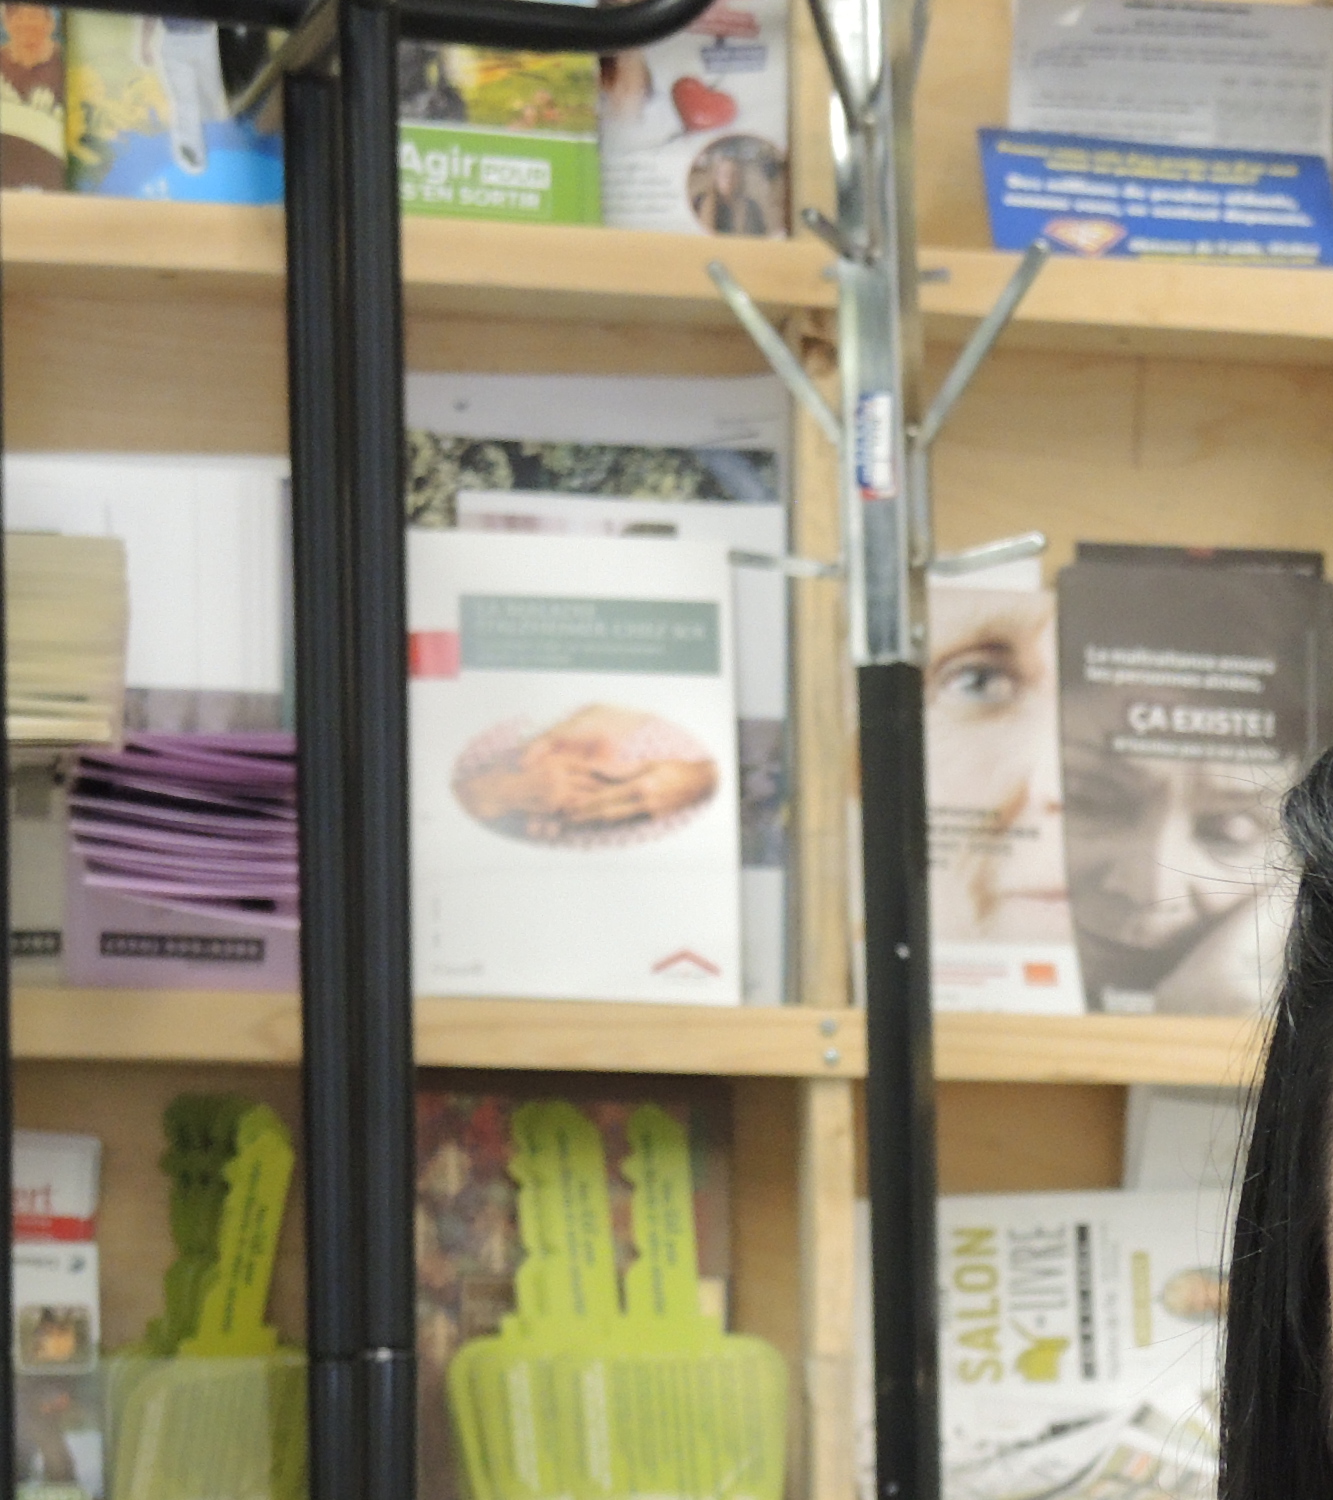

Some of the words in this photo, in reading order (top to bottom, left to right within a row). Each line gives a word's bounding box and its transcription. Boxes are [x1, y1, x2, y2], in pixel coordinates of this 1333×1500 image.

[400, 141, 473, 185] Agir
[1127, 700, 1170, 736] ÇA
[952, 1225, 1004, 1385] SALON
